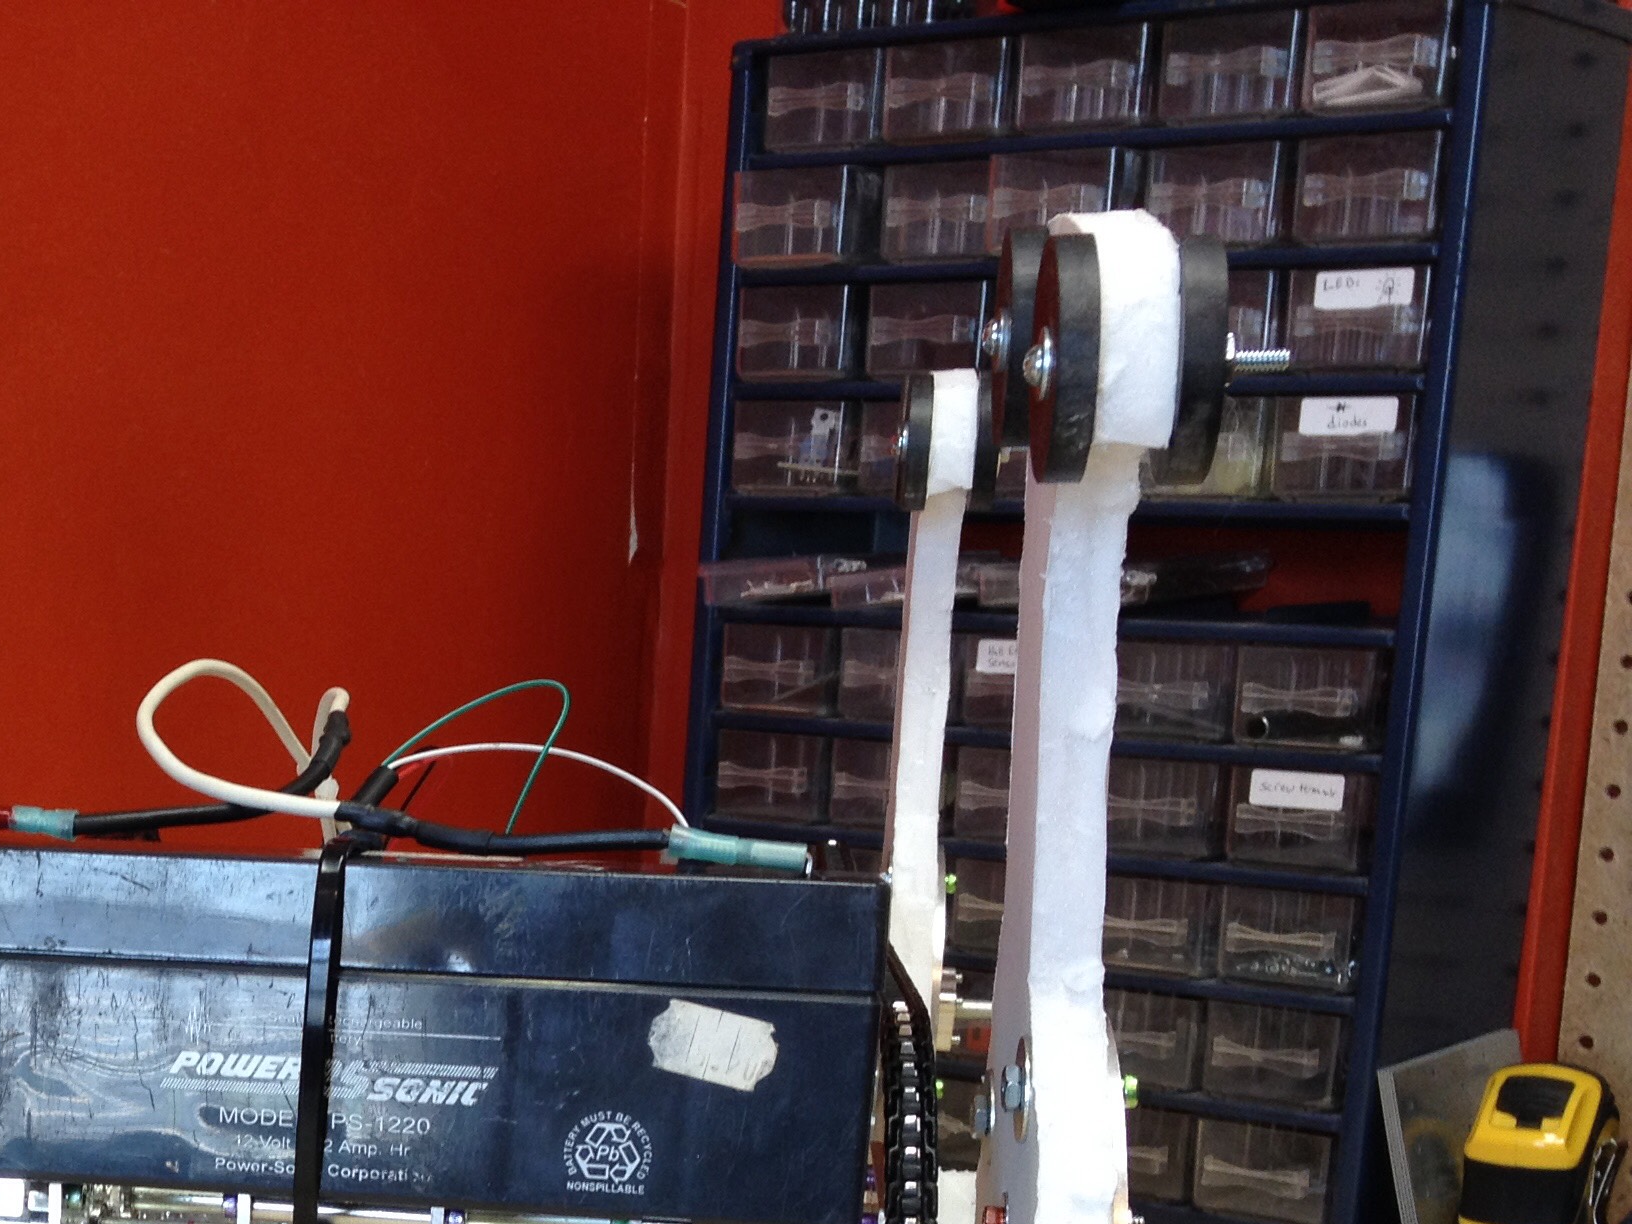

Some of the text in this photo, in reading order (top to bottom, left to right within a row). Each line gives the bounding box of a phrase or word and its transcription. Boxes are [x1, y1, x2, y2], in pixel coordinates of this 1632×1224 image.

[169, 1050, 301, 1081] POWER
[366, 1076, 488, 1107] SONIC
[219, 1106, 431, 1135] MODE PS-1220
[338, 1140, 382, 1158] Amp.
[563, 1110, 653, 1181] BATTERY MUST BE RECYCLED
[596, 1144, 620, 1162] Pb
[214, 1157, 296, 1175] Power-So
[566, 1180, 645, 1195] NONSPILLABLE
